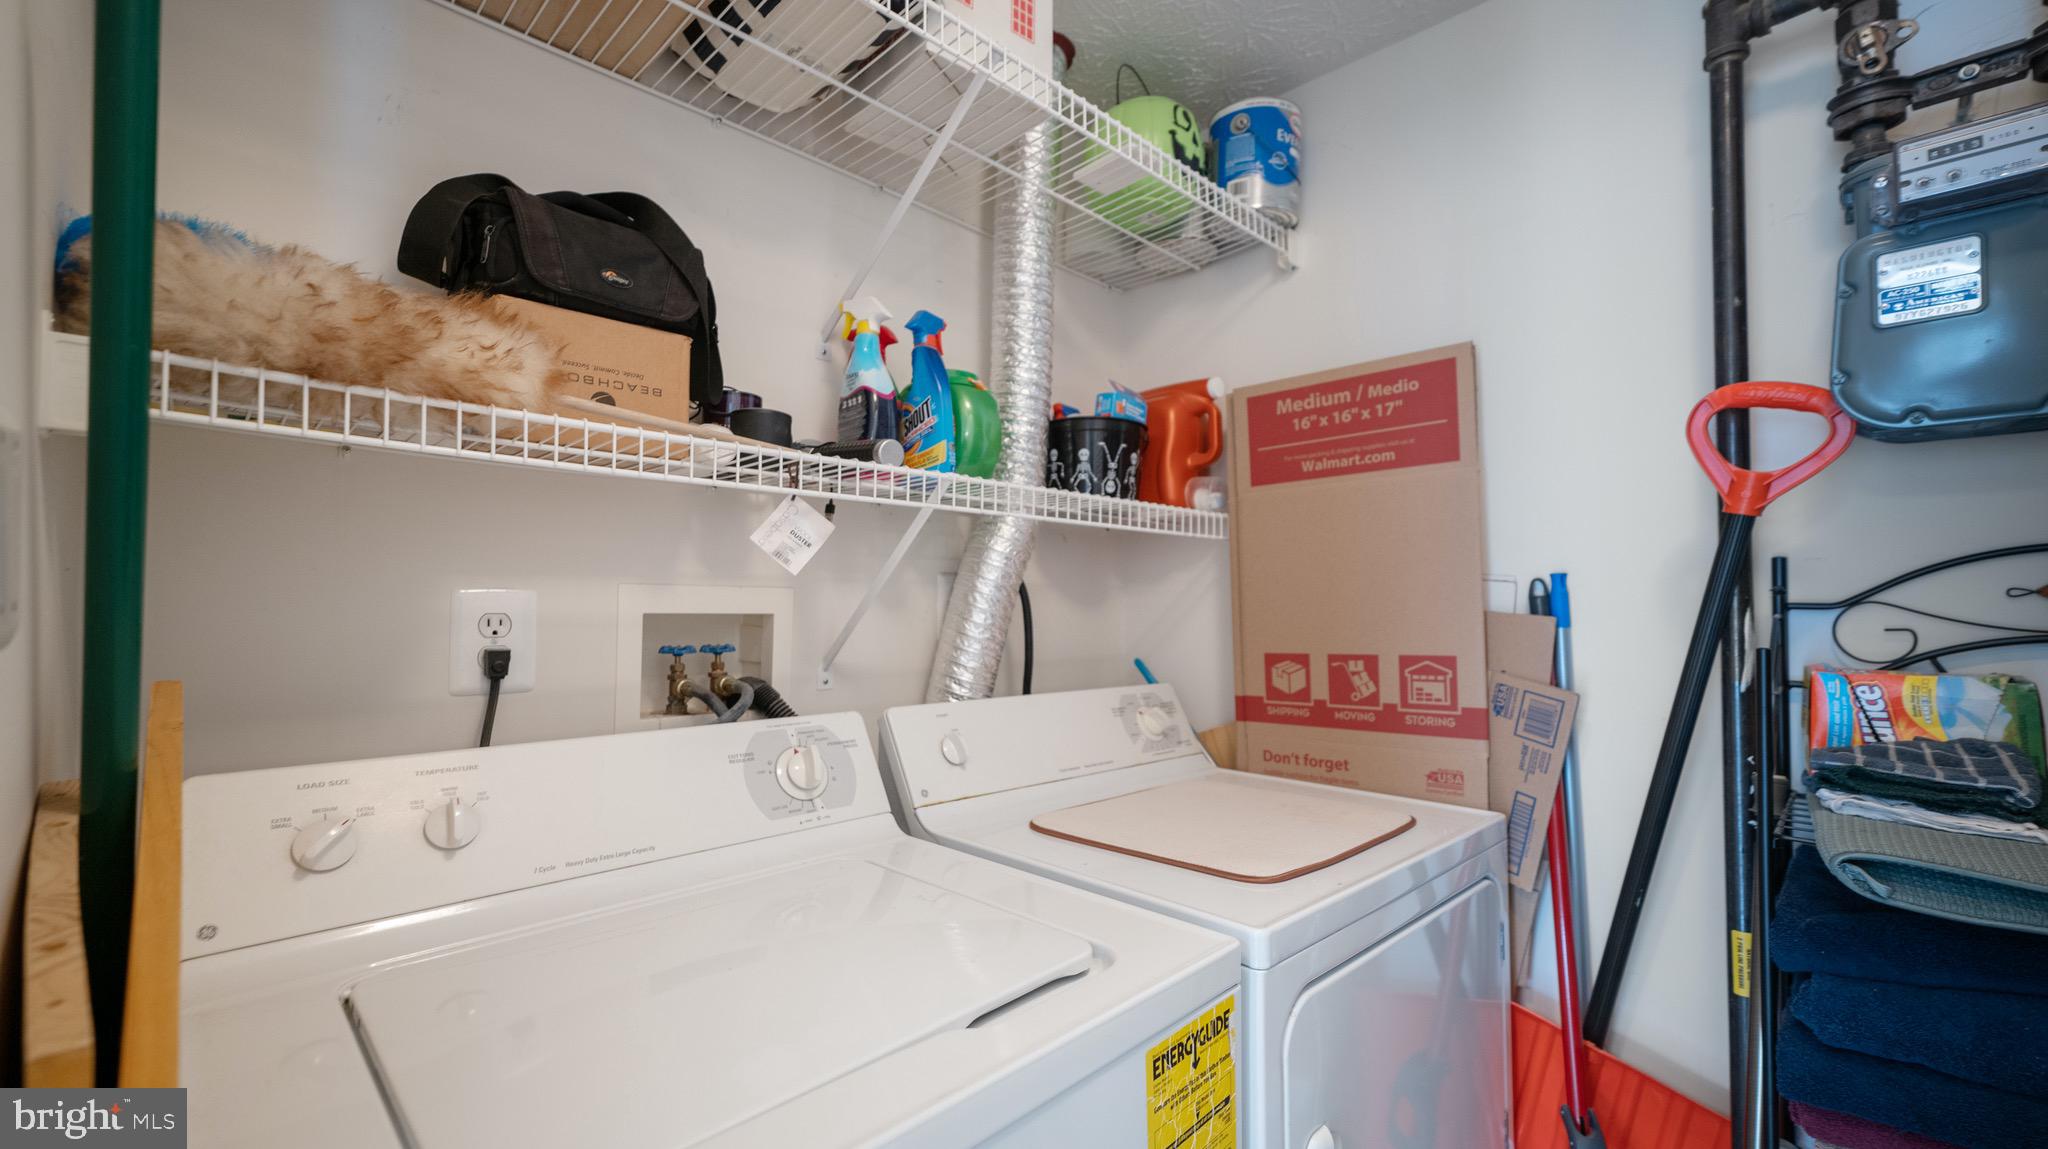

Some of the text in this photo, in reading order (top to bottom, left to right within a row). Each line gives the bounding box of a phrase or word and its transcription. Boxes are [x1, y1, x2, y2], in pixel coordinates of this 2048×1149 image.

[1276, 378, 1420, 416] Medium / Medio
[1292, 399, 1404, 432] 16" x 16" x 17"
[1301, 451, 1396, 472] Walmart.com
[789, 529, 812, 548] DUSTER
[1266, 706, 1311, 718] SHIPPING
[1334, 712, 1377, 723] MOVING
[1405, 715, 1456, 728] STORING
[1263, 749, 1350, 773] Don't forget
[415, 764, 479, 776] TEMPERATURE
[1437, 771, 1463, 785] USA
[296, 778, 351, 790] LOAD SIZE
[1152, 1008, 1231, 1081] ENERGYGUIDE
